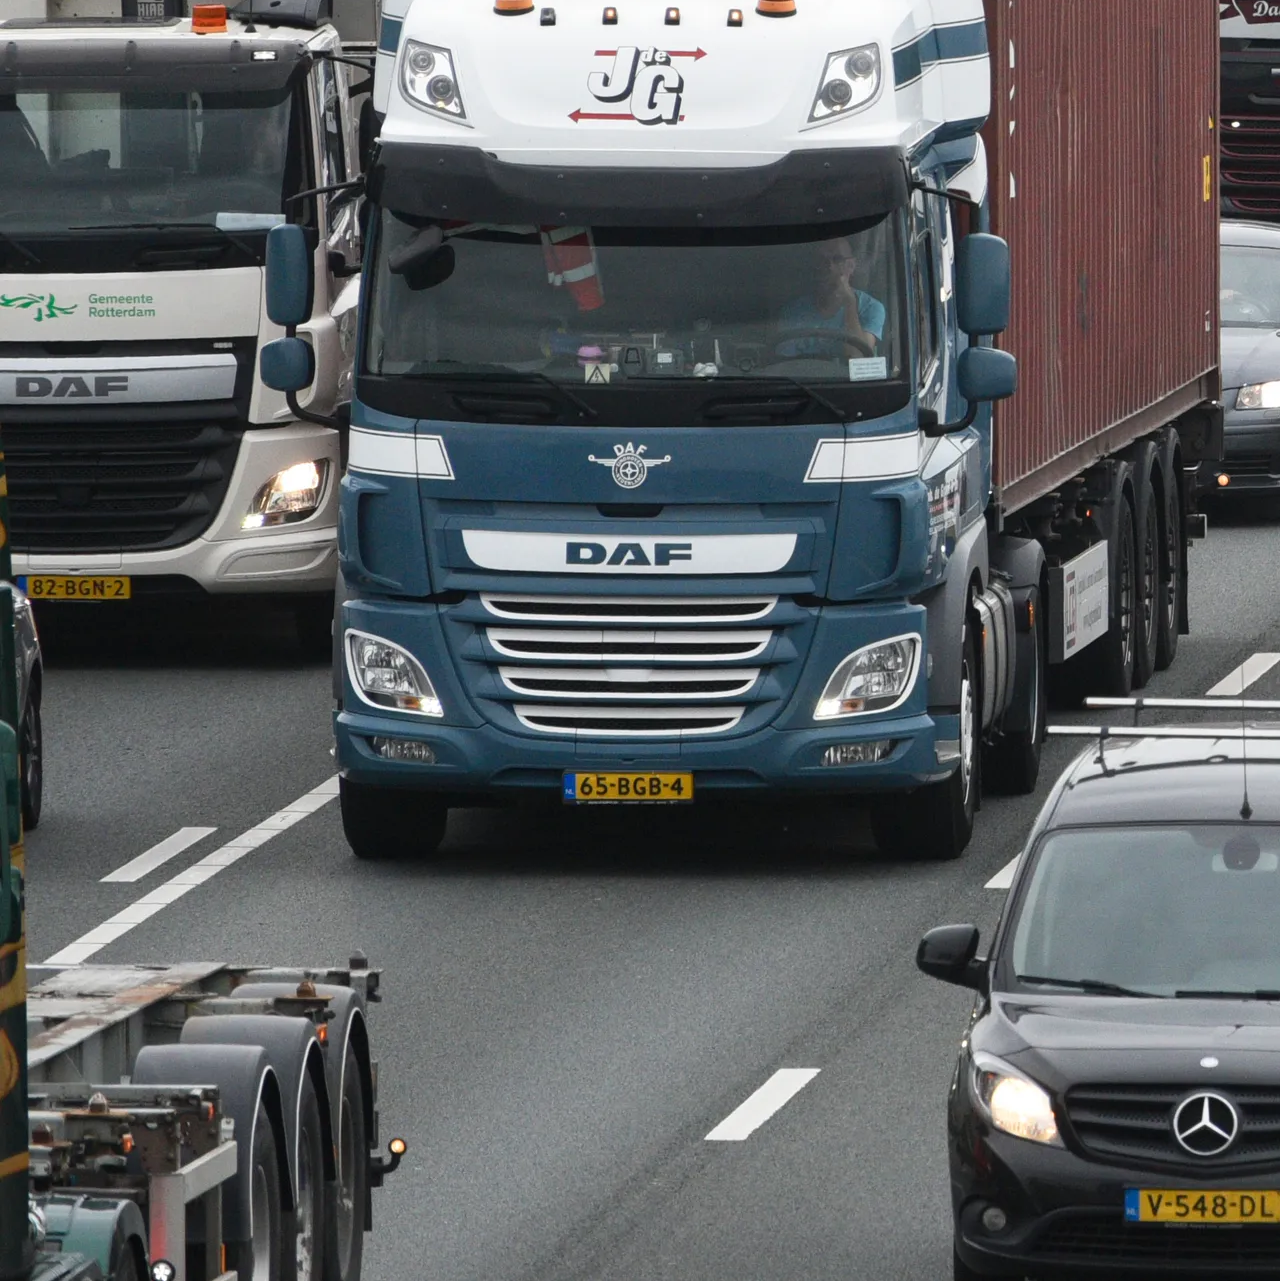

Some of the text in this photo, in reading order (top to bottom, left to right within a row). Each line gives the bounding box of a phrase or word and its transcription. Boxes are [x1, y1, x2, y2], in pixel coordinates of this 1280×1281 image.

[137, 3, 165, 17] HIAB
[88, 292, 154, 306] Gemeente
[88, 306, 156, 319] Rotterdam
[15, 376, 129, 398] DAF
[613, 441, 648, 457] DAF
[565, 542, 693, 567] DAF
[32, 578, 127, 598] 82-BGN-2
[579, 775, 685, 797] 65-BGB-4
[1147, 1194, 1274, 1218] V-548-DL
